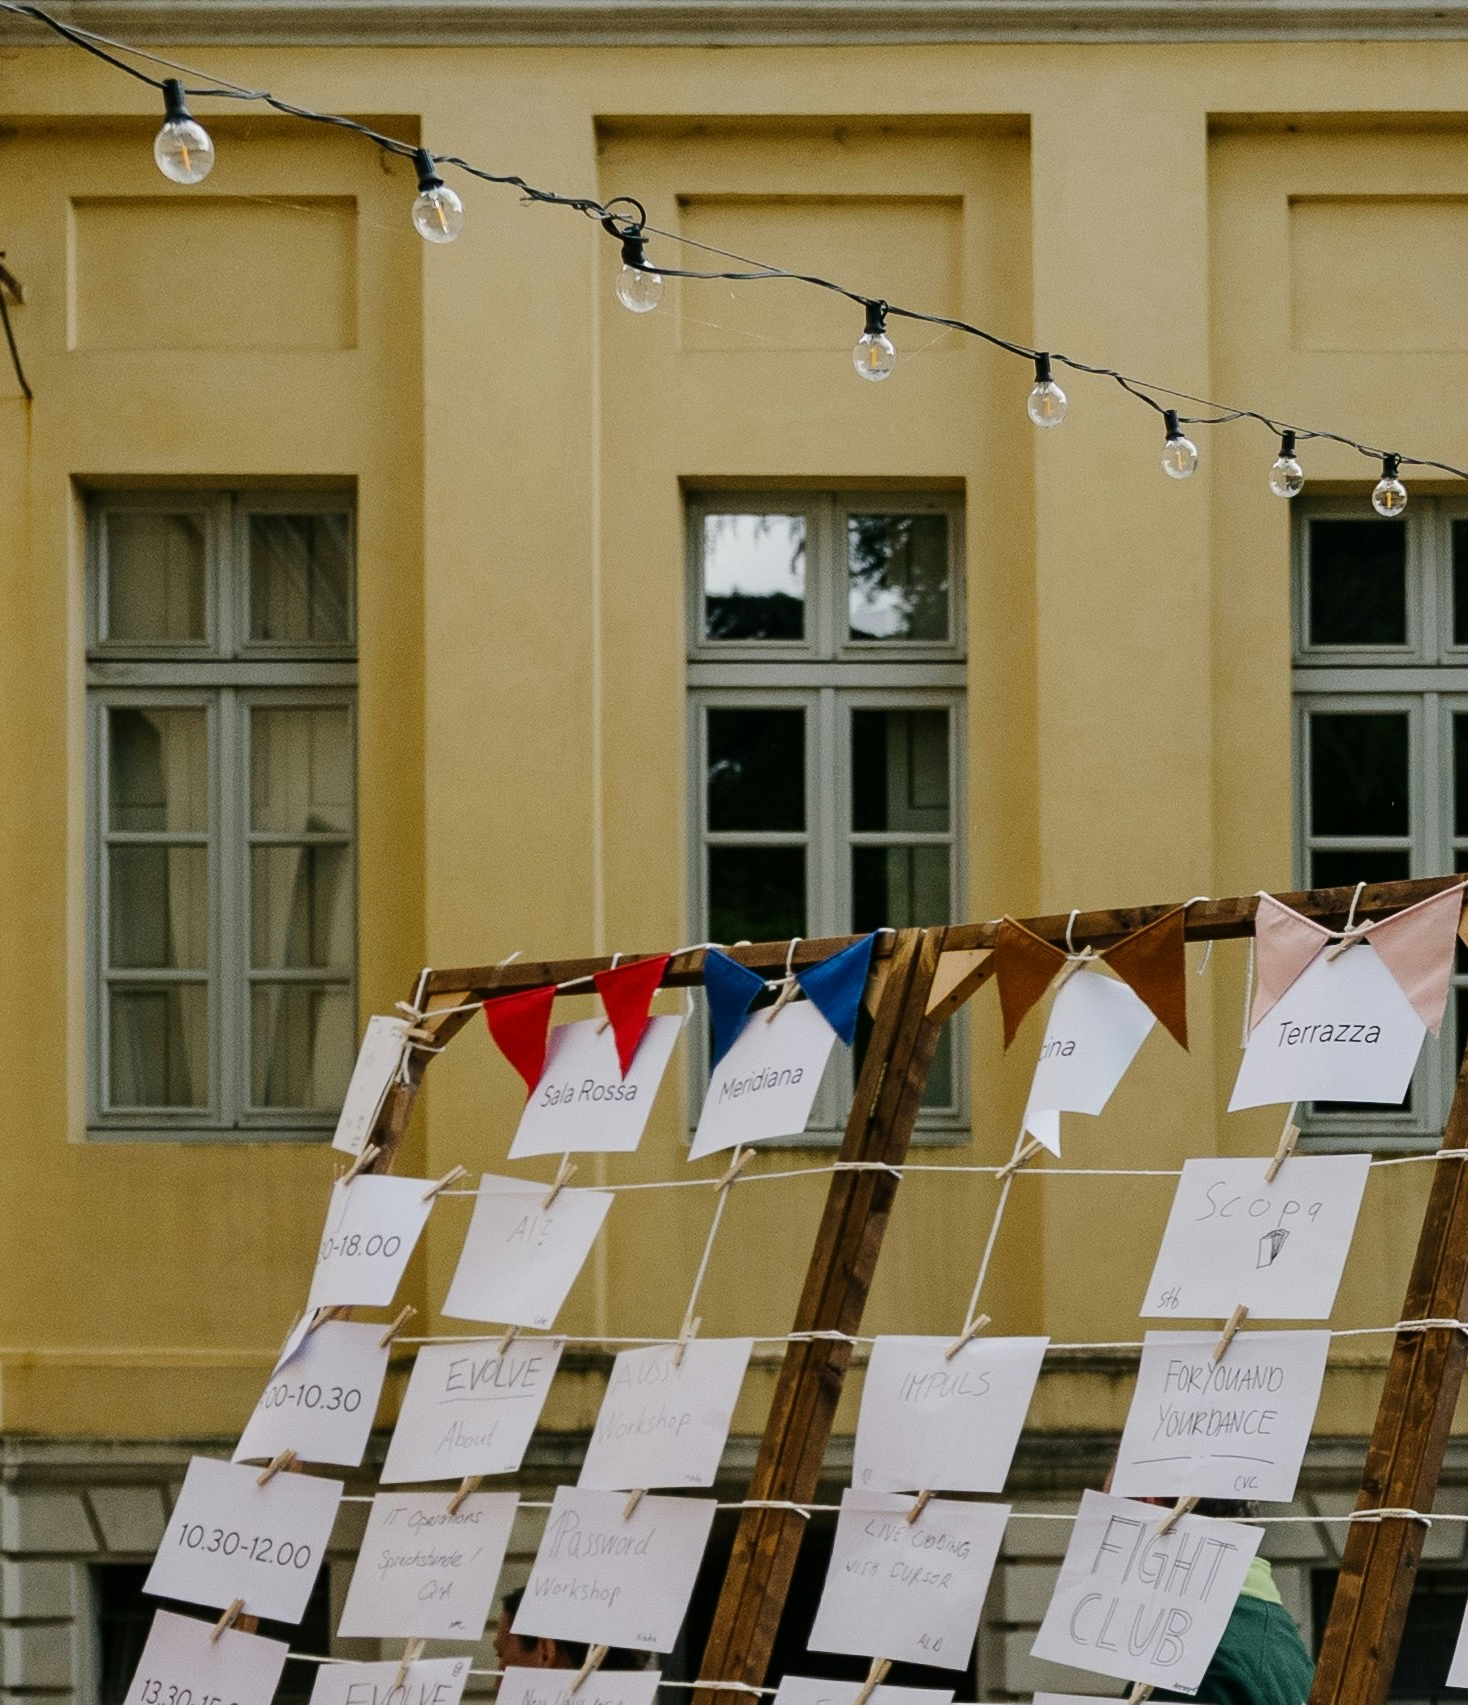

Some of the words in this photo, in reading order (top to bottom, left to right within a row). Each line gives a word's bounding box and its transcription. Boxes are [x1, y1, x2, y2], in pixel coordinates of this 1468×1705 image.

[1276, 1019, 1382, 1048] Terrazza
[540, 1082, 574, 1108] Sala
[578, 1079, 638, 1102] Rossa
[717, 1066, 804, 1104] Meridiana
[445, 1357, 542, 1392] EVOLVE
[899, 1370, 991, 1402] IMPULS
[178, 1522, 311, 1570] 10.30-12.00
[864, 1518, 905, 1543] LIVE
[1091, 1514, 1239, 1604] FIGHT
[1069, 1592, 1193, 1667] CLUB
